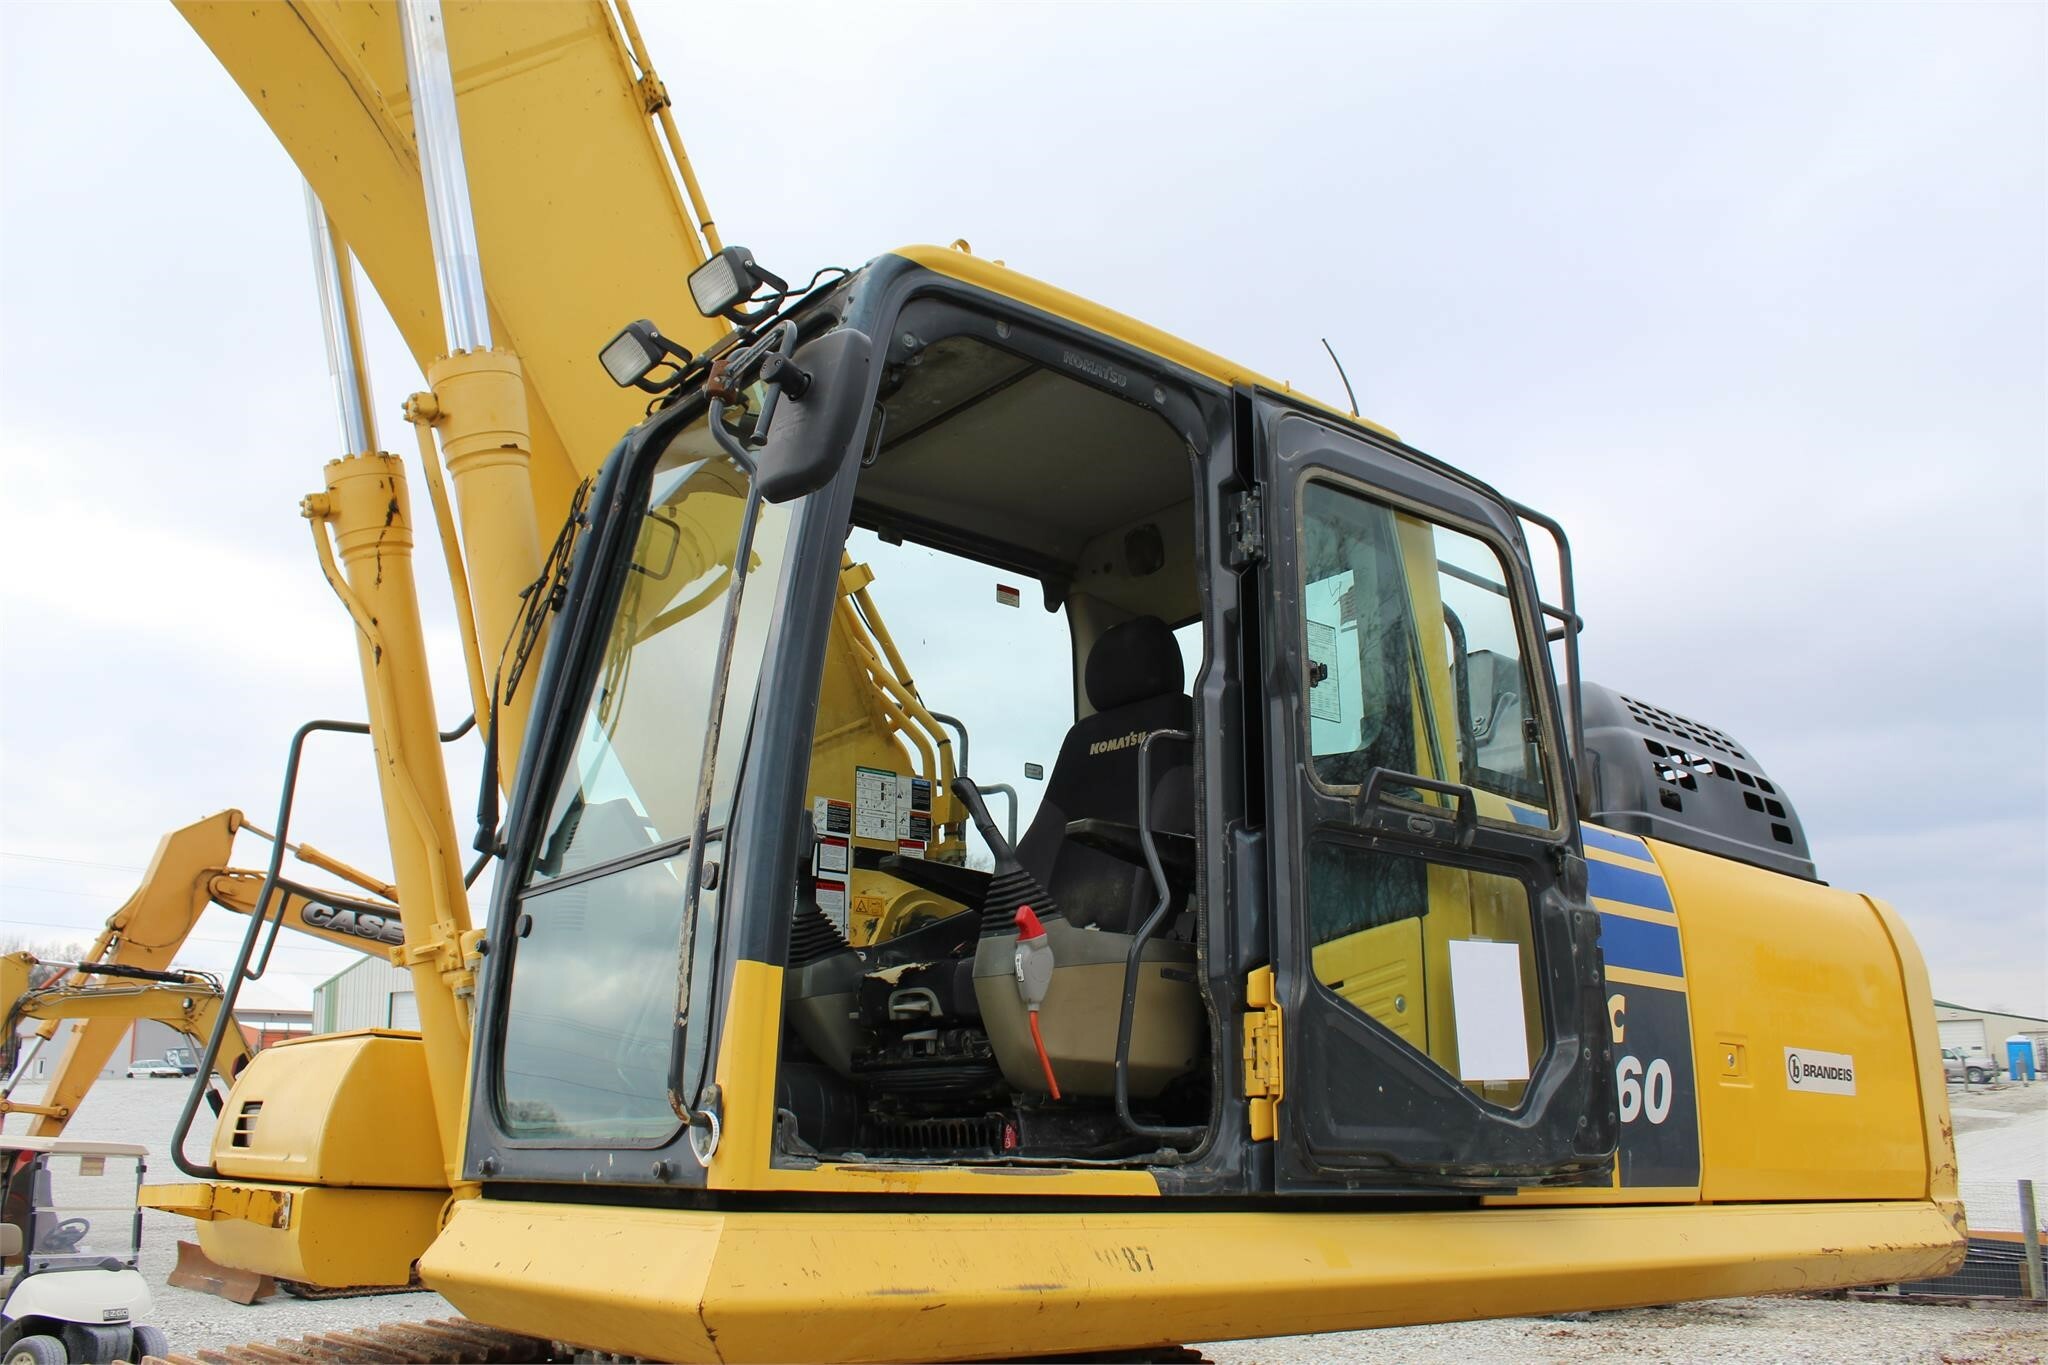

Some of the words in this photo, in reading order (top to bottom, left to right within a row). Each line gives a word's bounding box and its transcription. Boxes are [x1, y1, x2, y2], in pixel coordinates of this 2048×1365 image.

[1063, 351, 1127, 387] KOMATSU
[301, 901, 405, 945] CASE
[1803, 1064, 1853, 1082] BRANDEIS
